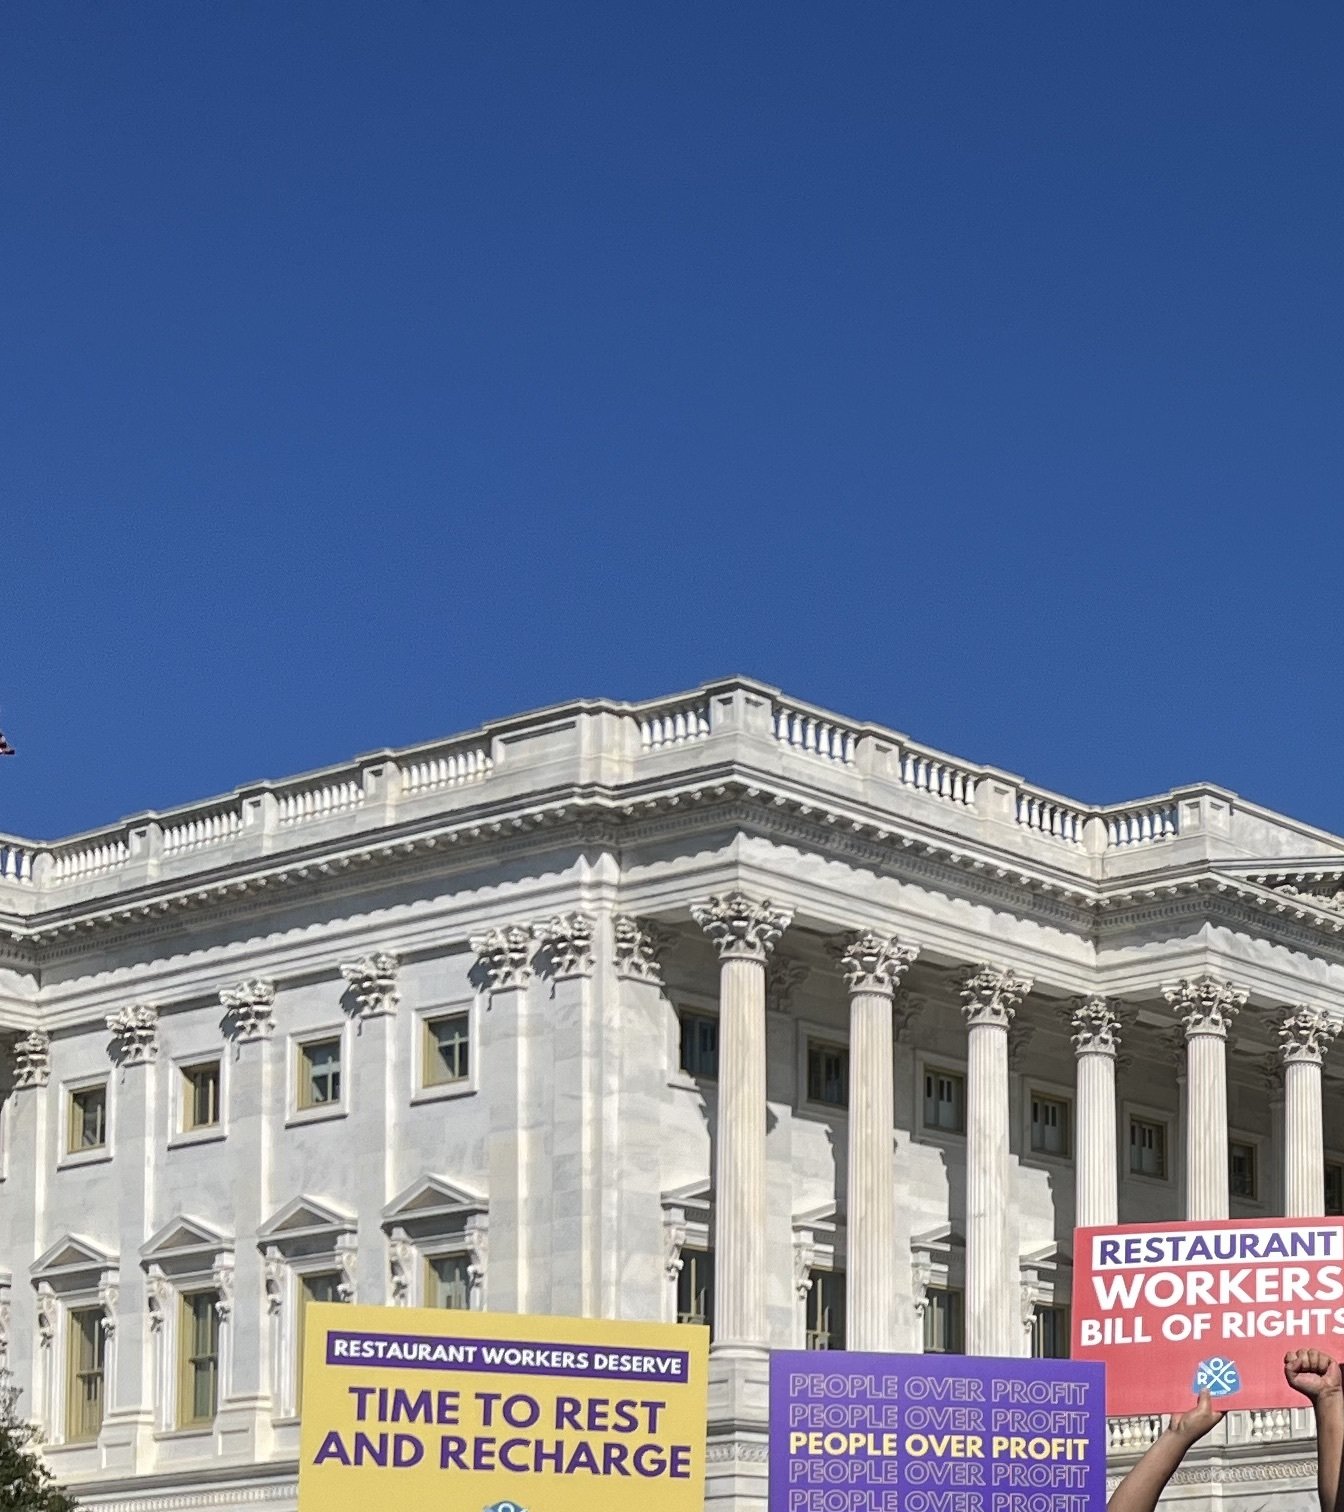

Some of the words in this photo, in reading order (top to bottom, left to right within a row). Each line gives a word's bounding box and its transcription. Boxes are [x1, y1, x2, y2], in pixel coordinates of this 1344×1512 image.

[1099, 1230, 1338, 1266] RESTAURANT
[1091, 1265, 1344, 1311] WORKERS
[1080, 1315, 1153, 1347] BILL
[1161, 1312, 1212, 1342] OF
[333, 1338, 478, 1364] RESTAURANT
[481, 1346, 590, 1370] WORKERS
[593, 1352, 682, 1376] DESERVE
[789, 1373, 898, 1400] PEOPLE
[904, 1376, 986, 1402] OVER
[991, 1379, 1090, 1406] PROFIT
[347, 1386, 460, 1426] TIME
[474, 1393, 541, 1429] TO
[554, 1396, 667, 1434] REST
[789, 1404, 898, 1430] PEOPLE
[904, 1406, 986, 1432] OVER
[991, 1408, 1090, 1435] PROFIT
[312, 1431, 425, 1468] AND
[440, 1435, 692, 1479] RECHARGE
[789, 1431, 898, 1457] PEOPLE
[904, 1434, 985, 1459] OVER
[992, 1436, 1089, 1461] PROFIT
[788, 1458, 898, 1485] PEOPLE
[904, 1460, 986, 1486] OVER
[991, 1463, 1090, 1489] PROFIT
